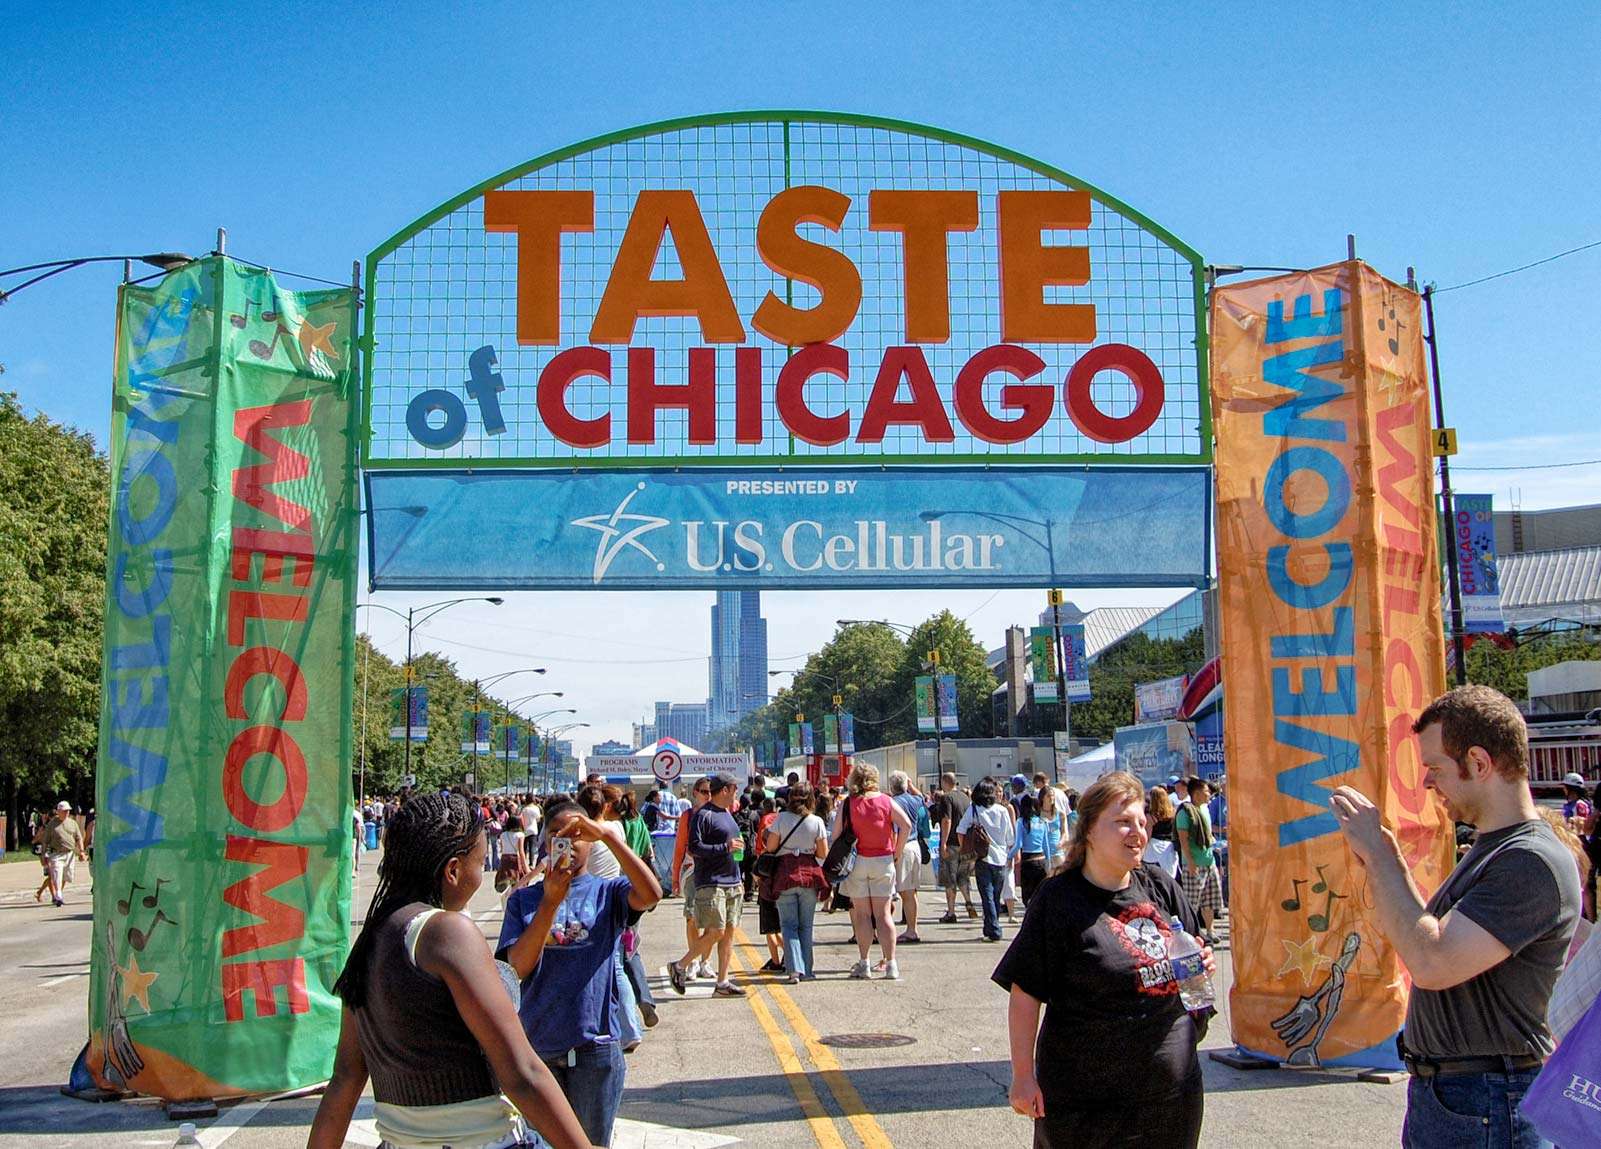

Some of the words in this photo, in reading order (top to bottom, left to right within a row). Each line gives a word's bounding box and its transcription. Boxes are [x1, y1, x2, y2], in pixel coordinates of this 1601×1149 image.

[484, 185, 1097, 346] TASTE
[405, 345, 506, 450] of
[537, 343, 1165, 447] CHICAGO
[1438, 431, 1449, 450] 4
[726, 480, 829, 495] PRESENTED
[834, 480, 858, 494] BY
[107, 288, 196, 868] WELCOME
[681, 520, 774, 571] U.S.
[781, 520, 1004, 571] Cellular
[1262, 287, 1361, 847] WELCOME
[1457, 511, 1476, 594] CHICAGO
[1376, 403, 1437, 902] WELCOM
[221, 399, 315, 1023] WELCOME
[686, 757, 743, 765] INFORMATION
